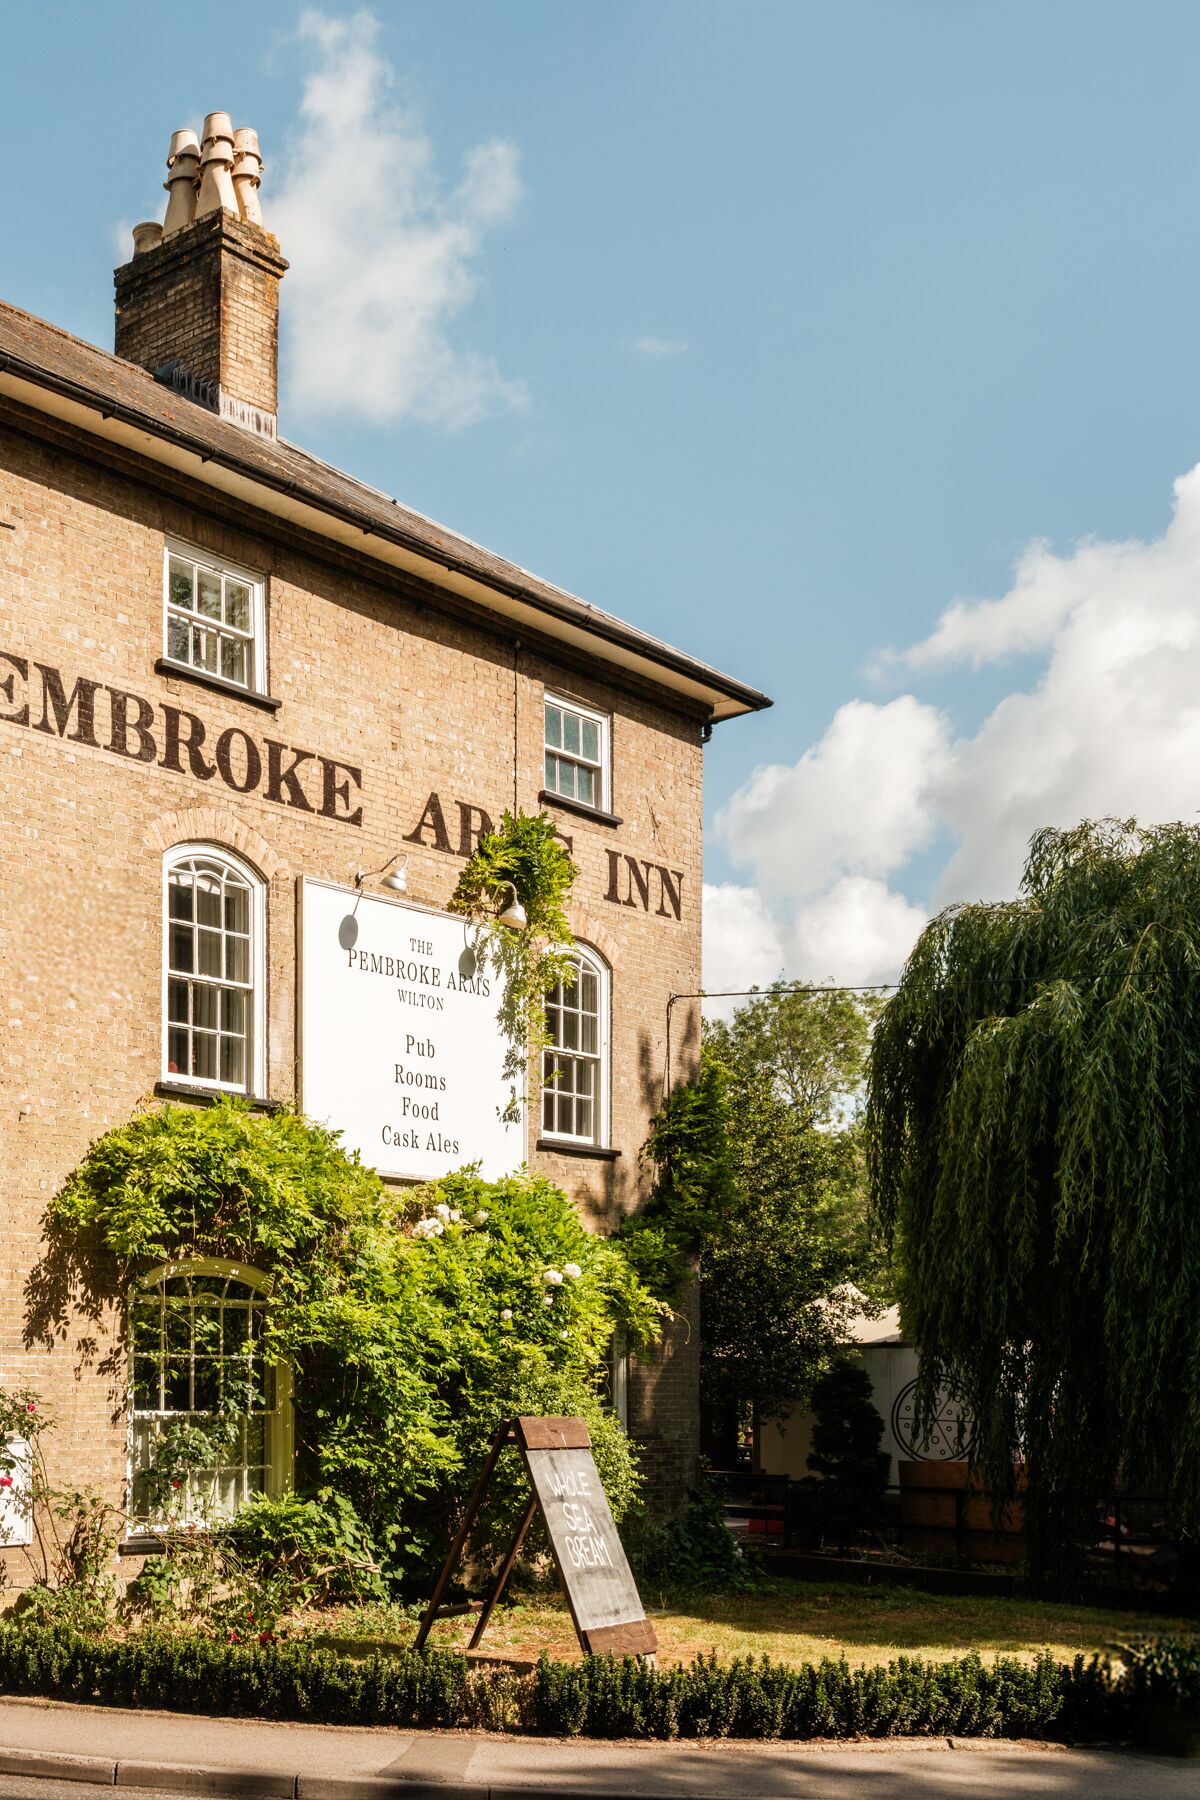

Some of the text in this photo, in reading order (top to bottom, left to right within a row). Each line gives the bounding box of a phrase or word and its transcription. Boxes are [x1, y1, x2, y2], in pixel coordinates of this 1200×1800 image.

[402, 791, 574, 880] AR
[603, 848, 684, 921] INN
[409, 938, 433, 956] THE
[348, 948, 490, 998] PEMBROKE ARMS
[397, 989, 444, 1010] WILTON
[405, 1035, 436, 1058] Pub
[394, 1064, 447, 1091] Rooms
[402, 1097, 439, 1121] Food
[382, 1125, 459, 1155] Cask Ales
[545, 1471, 592, 1497] WHOLE
[562, 1502, 598, 1534] SEA
[565, 1535, 614, 1568] BREAM
